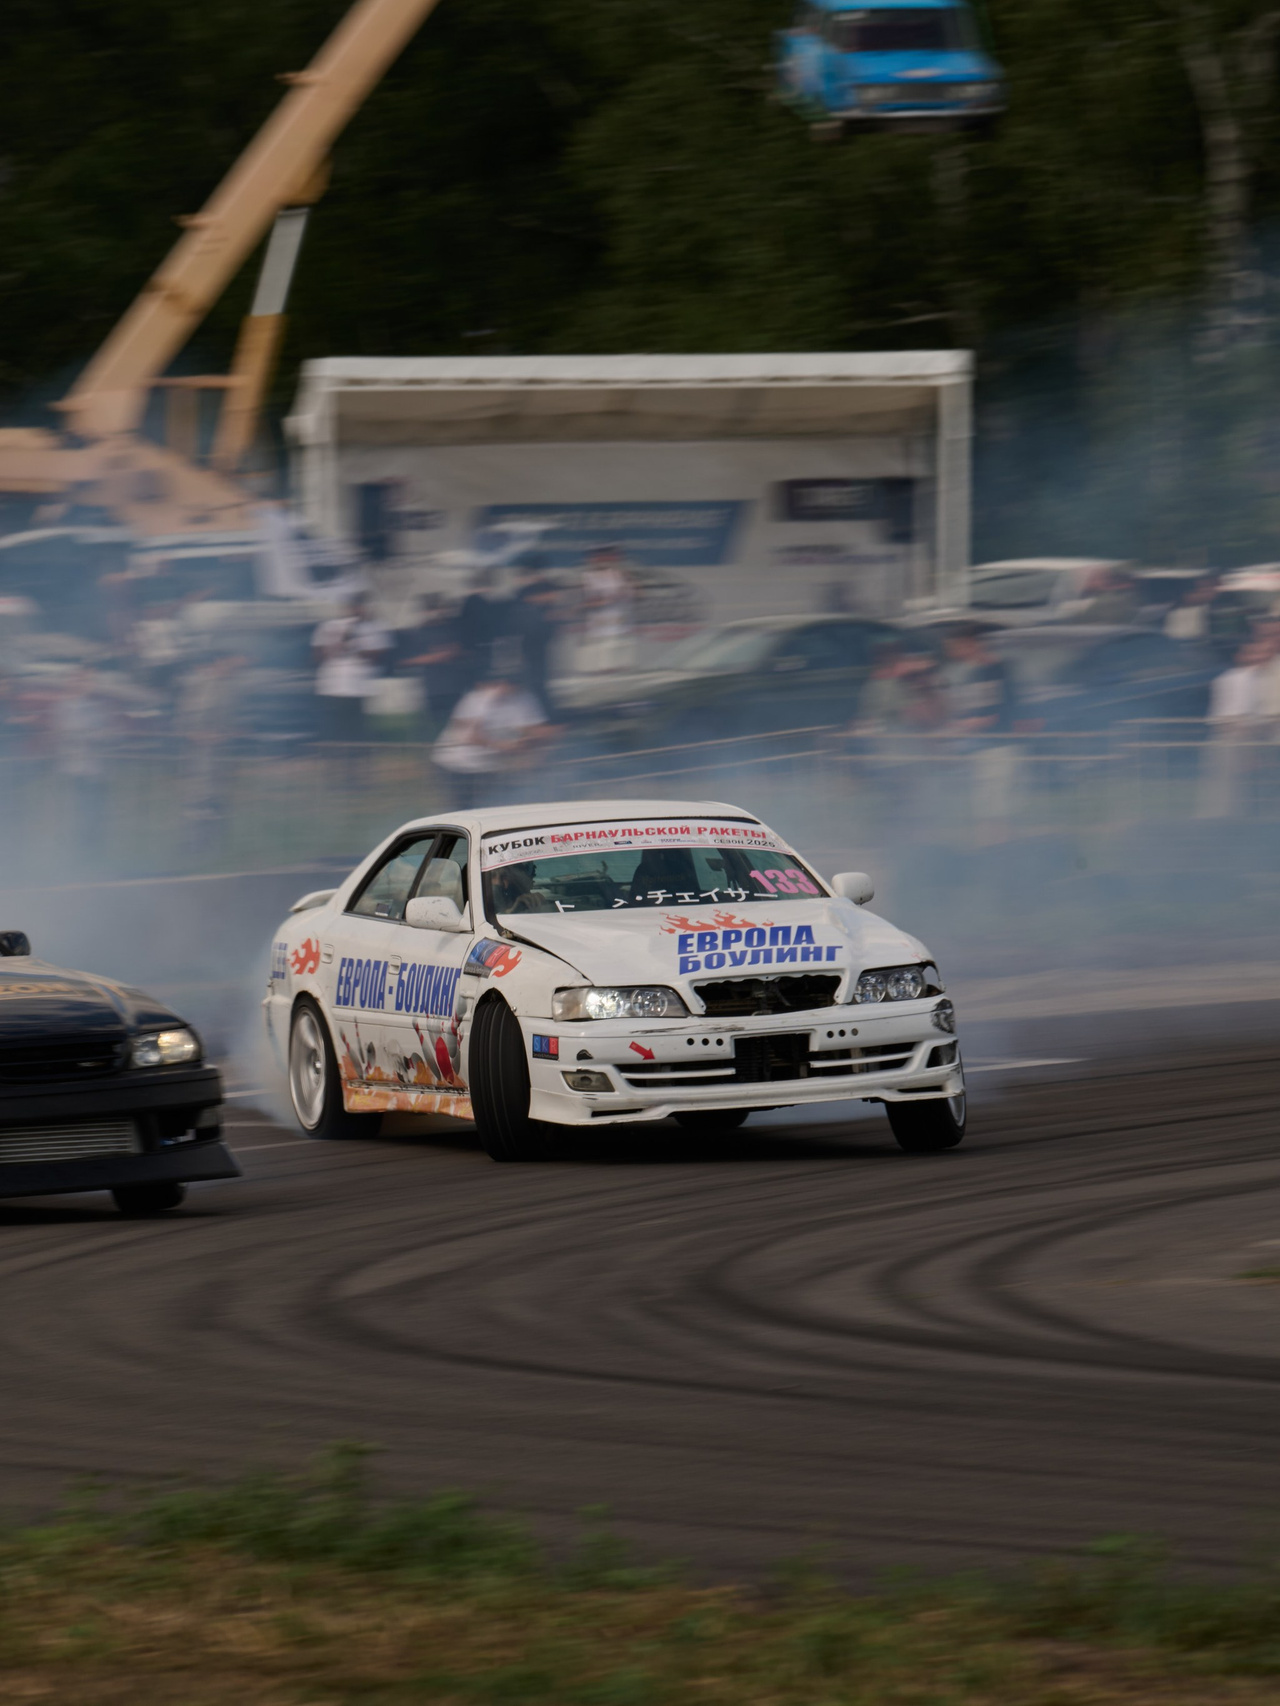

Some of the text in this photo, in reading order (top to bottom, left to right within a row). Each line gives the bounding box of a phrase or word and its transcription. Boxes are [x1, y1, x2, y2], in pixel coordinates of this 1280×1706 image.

[488, 836, 545, 855] КУБОК
[551, 825, 691, 843] БАРНАУЛЬСКОЙ
[697, 826, 766, 839] РАКЕТЫ
[749, 869, 819, 895] 133
[678, 925, 815, 955] ЕВРОПА
[679, 946, 843, 976] БОУЛИНГ
[335, 957, 389, 1010] ЕВРОПА
[395, 962, 462, 1017] БОУЛИНГ
